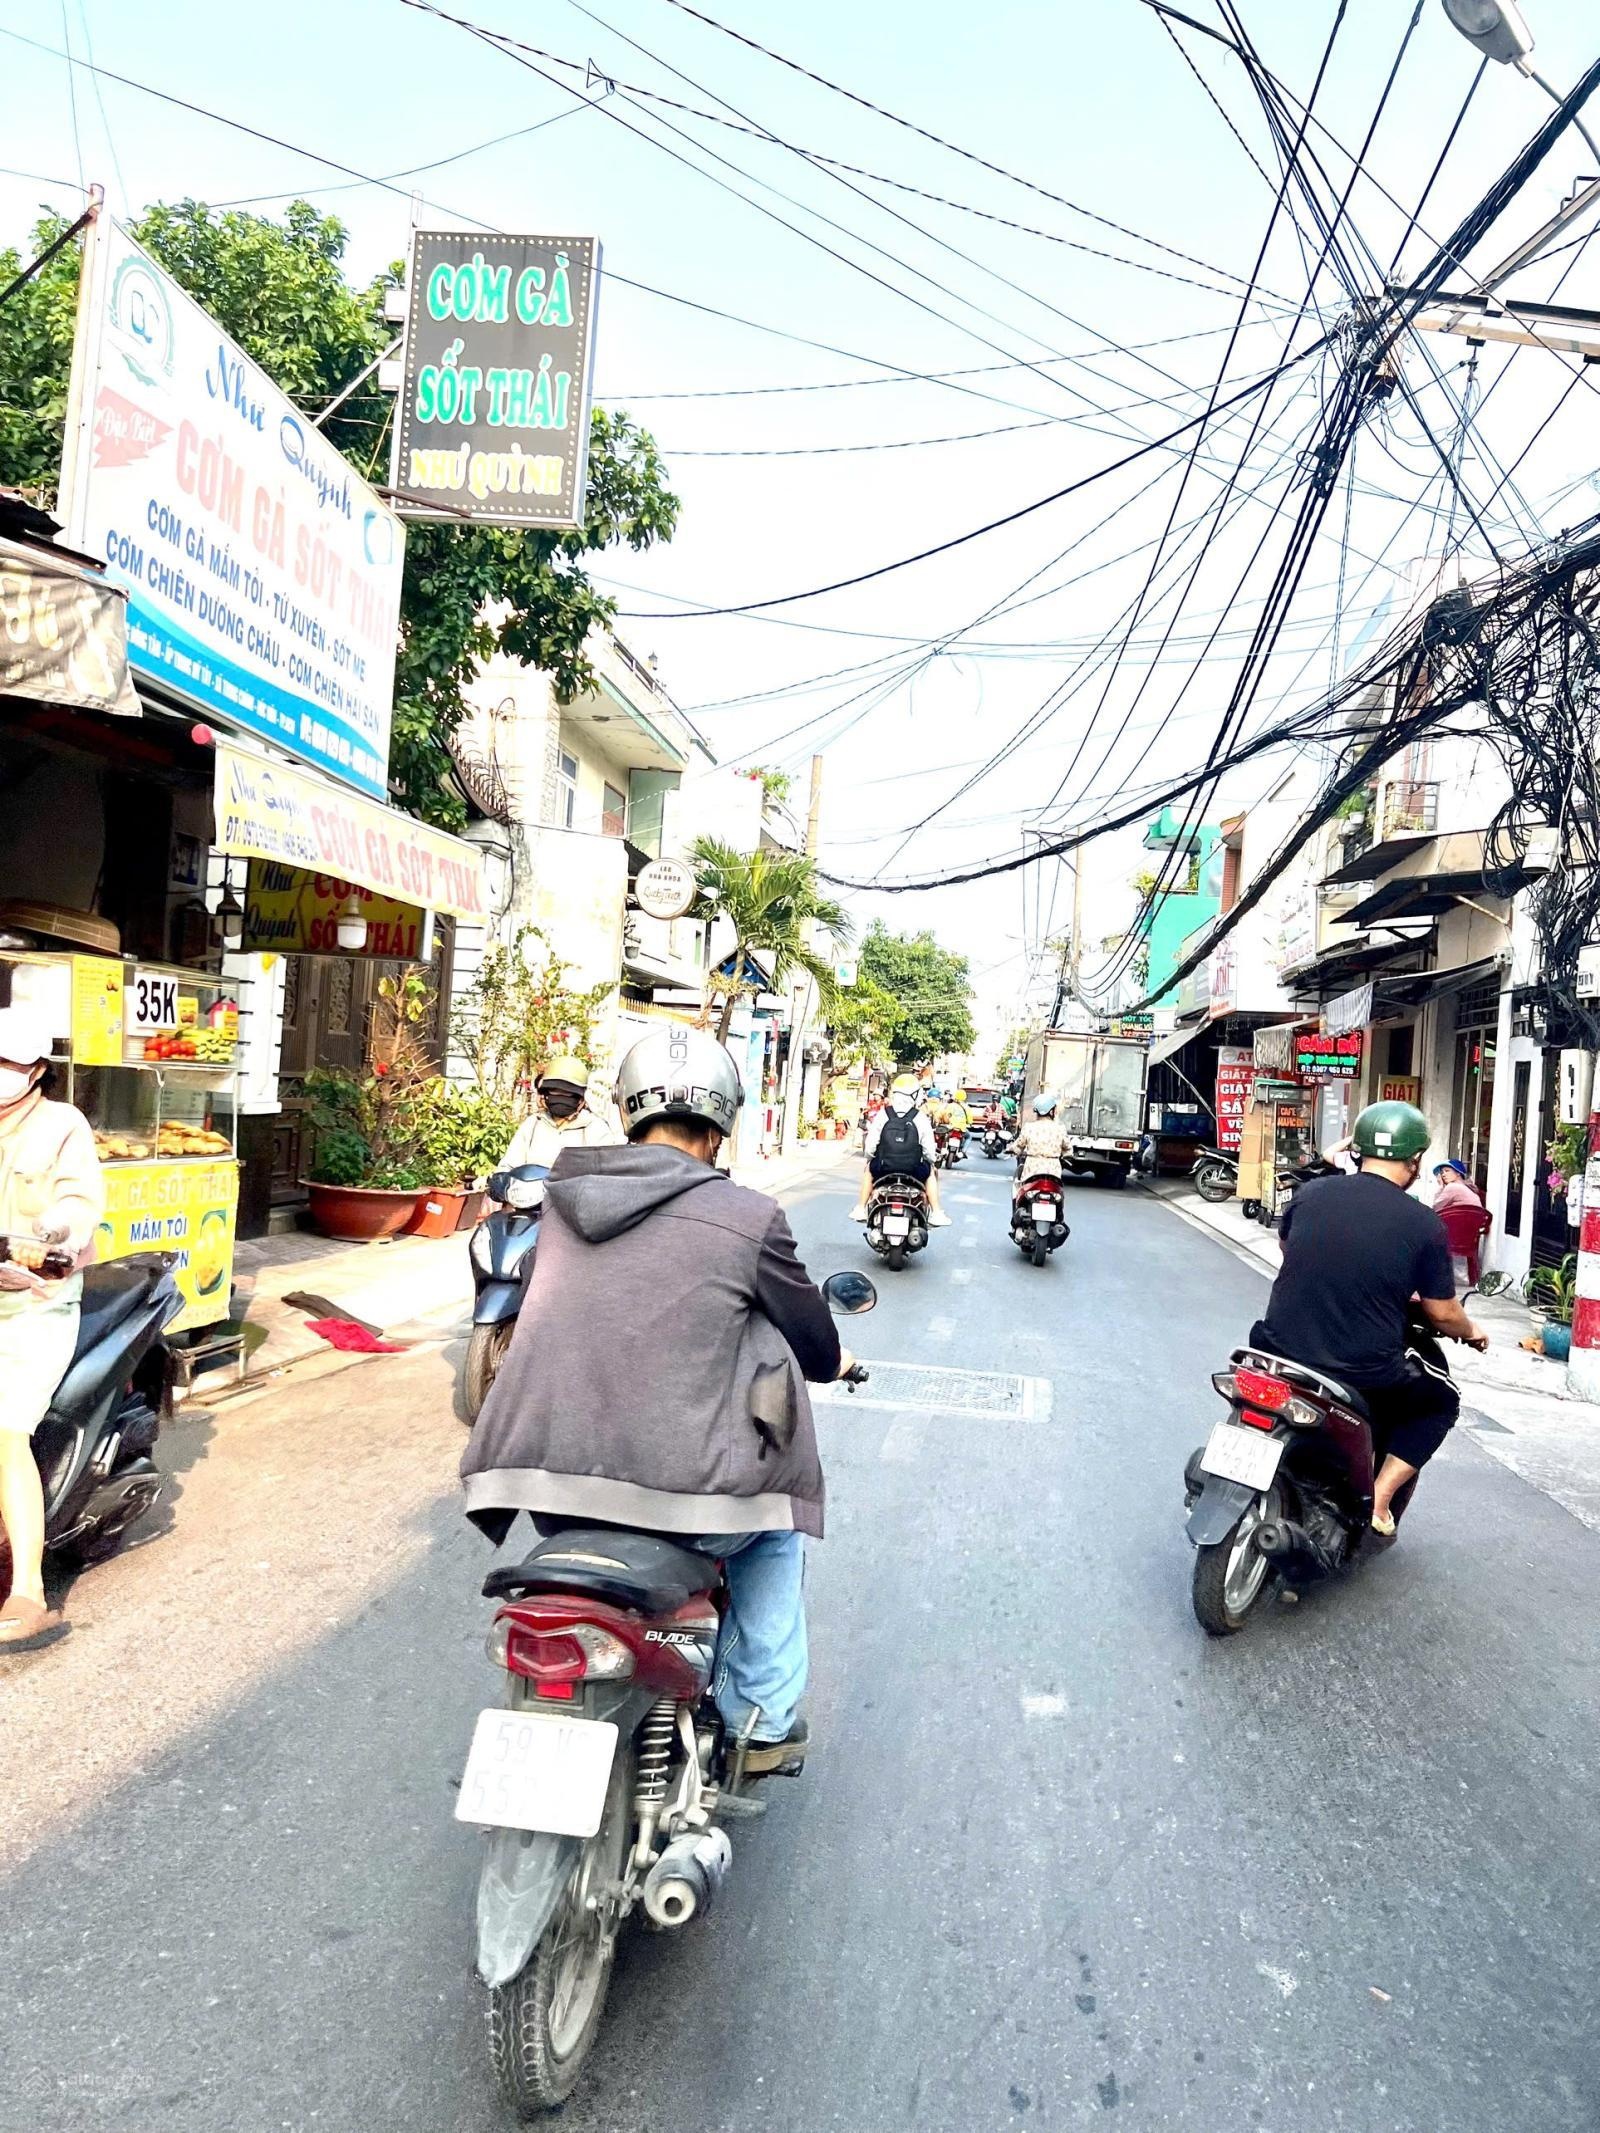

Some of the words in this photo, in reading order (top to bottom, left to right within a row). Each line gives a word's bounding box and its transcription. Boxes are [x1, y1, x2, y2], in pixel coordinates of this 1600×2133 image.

[427, 252, 513, 324] CƠM
[515, 250, 574, 327] GÀ
[415, 337, 482, 425] SỐT
[485, 353, 572, 430] THÁI
[206, 345, 265, 432] Như
[280, 415, 351, 520] Quỳnh
[408, 442, 470, 489] NHƯ
[468, 442, 564, 499] QUỲNH
[176, 418, 244, 534] CƠM
[253, 485, 286, 570] GÀ
[295, 522, 343, 611] SỐT
[147, 498, 181, 549] CƠM
[185, 527, 206, 566] GÀ
[209, 543, 240, 591] MẮM
[244, 565, 264, 608] TỎI
[291, 604, 326, 653] XUYÊN
[106, 529, 143, 580] CƠM
[147, 556, 195, 613] CHIÊN
[198, 590, 244, 645] DƯƠNG
[247, 624, 280, 668] CHÂU
[288, 653, 313, 690] CƠM
[314, 669, 343, 709] CHIÊN
[311, 803, 365, 874] CƠM
[365, 819, 395, 886] GÀ
[397, 829, 433, 900] SỐT
[438, 855, 482, 913] THÁI
[136, 979, 176, 1024] 35K
[1221, 1097, 1245, 1114] SẤ
[130, 1214, 162, 1242] MẮM
[167, 1211, 188, 1237] TỎI
[645, 1630, 696, 1648] BLADE
